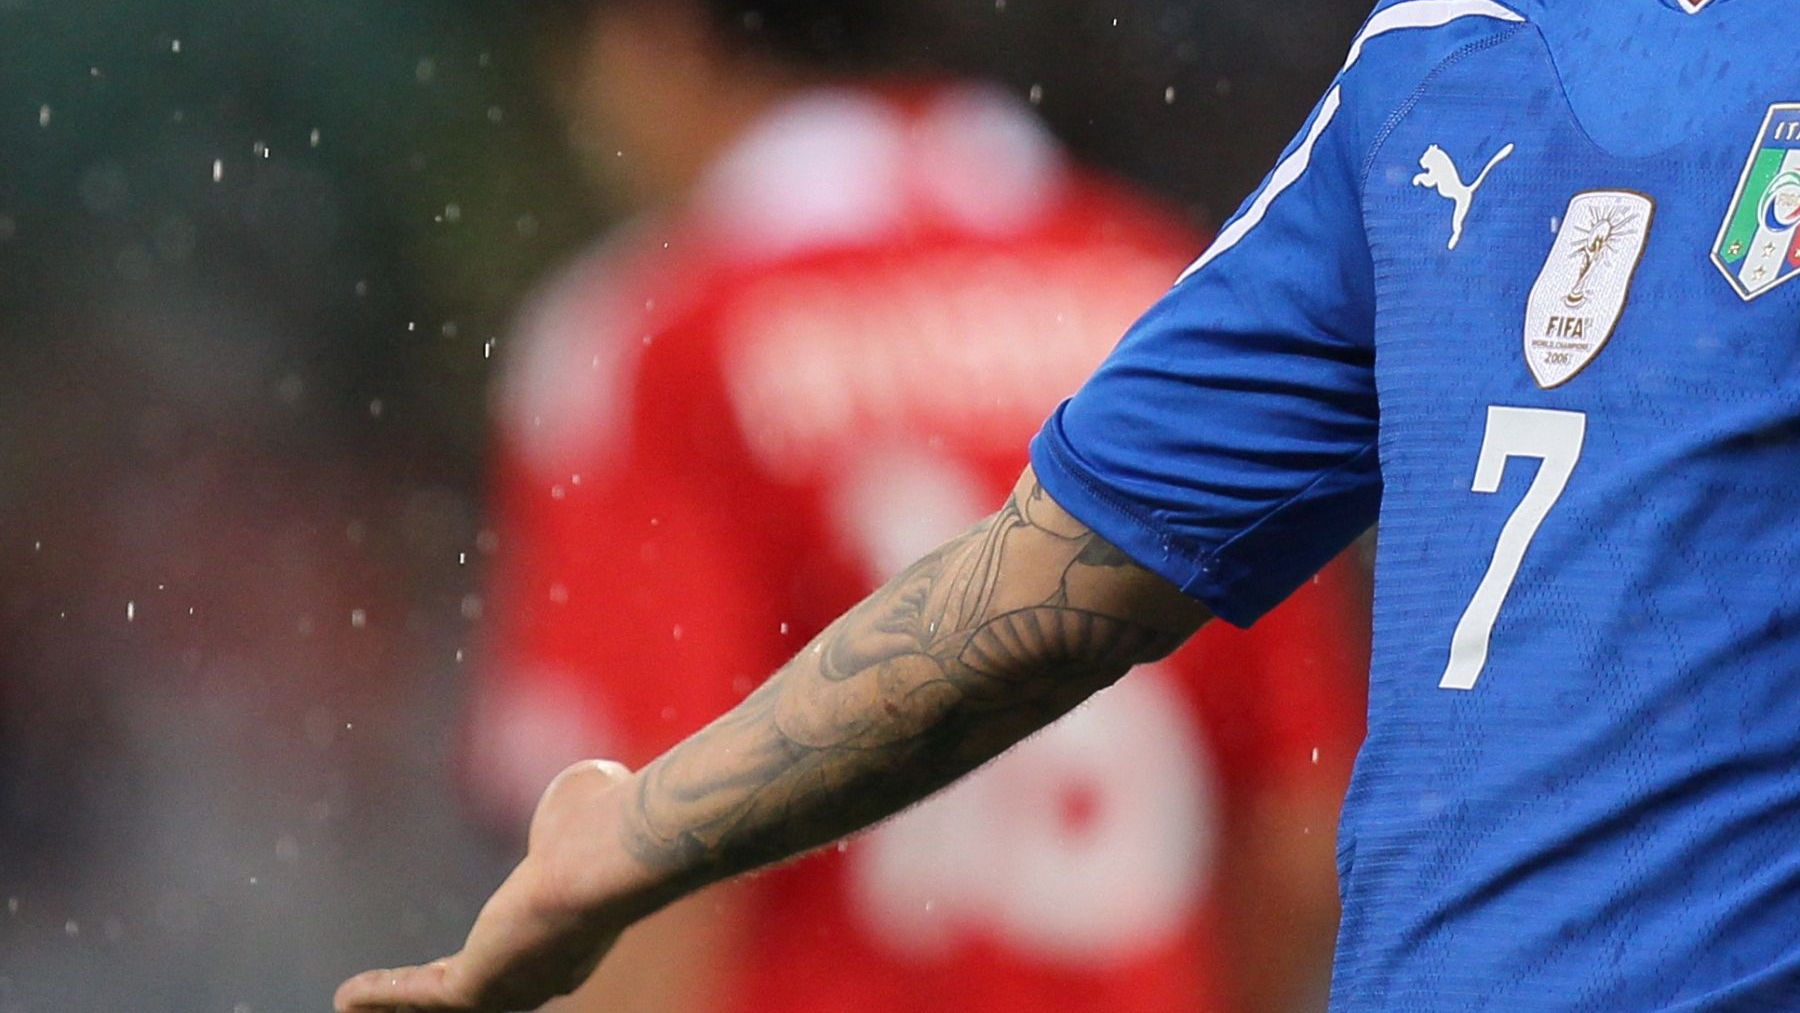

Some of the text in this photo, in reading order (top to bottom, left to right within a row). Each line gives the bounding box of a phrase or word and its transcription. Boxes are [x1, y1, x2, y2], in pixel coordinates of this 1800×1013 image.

[1546, 316, 1583, 338] FIFA
[1544, 352, 1569, 364] 2006
[1438, 405, 1586, 690] 7
